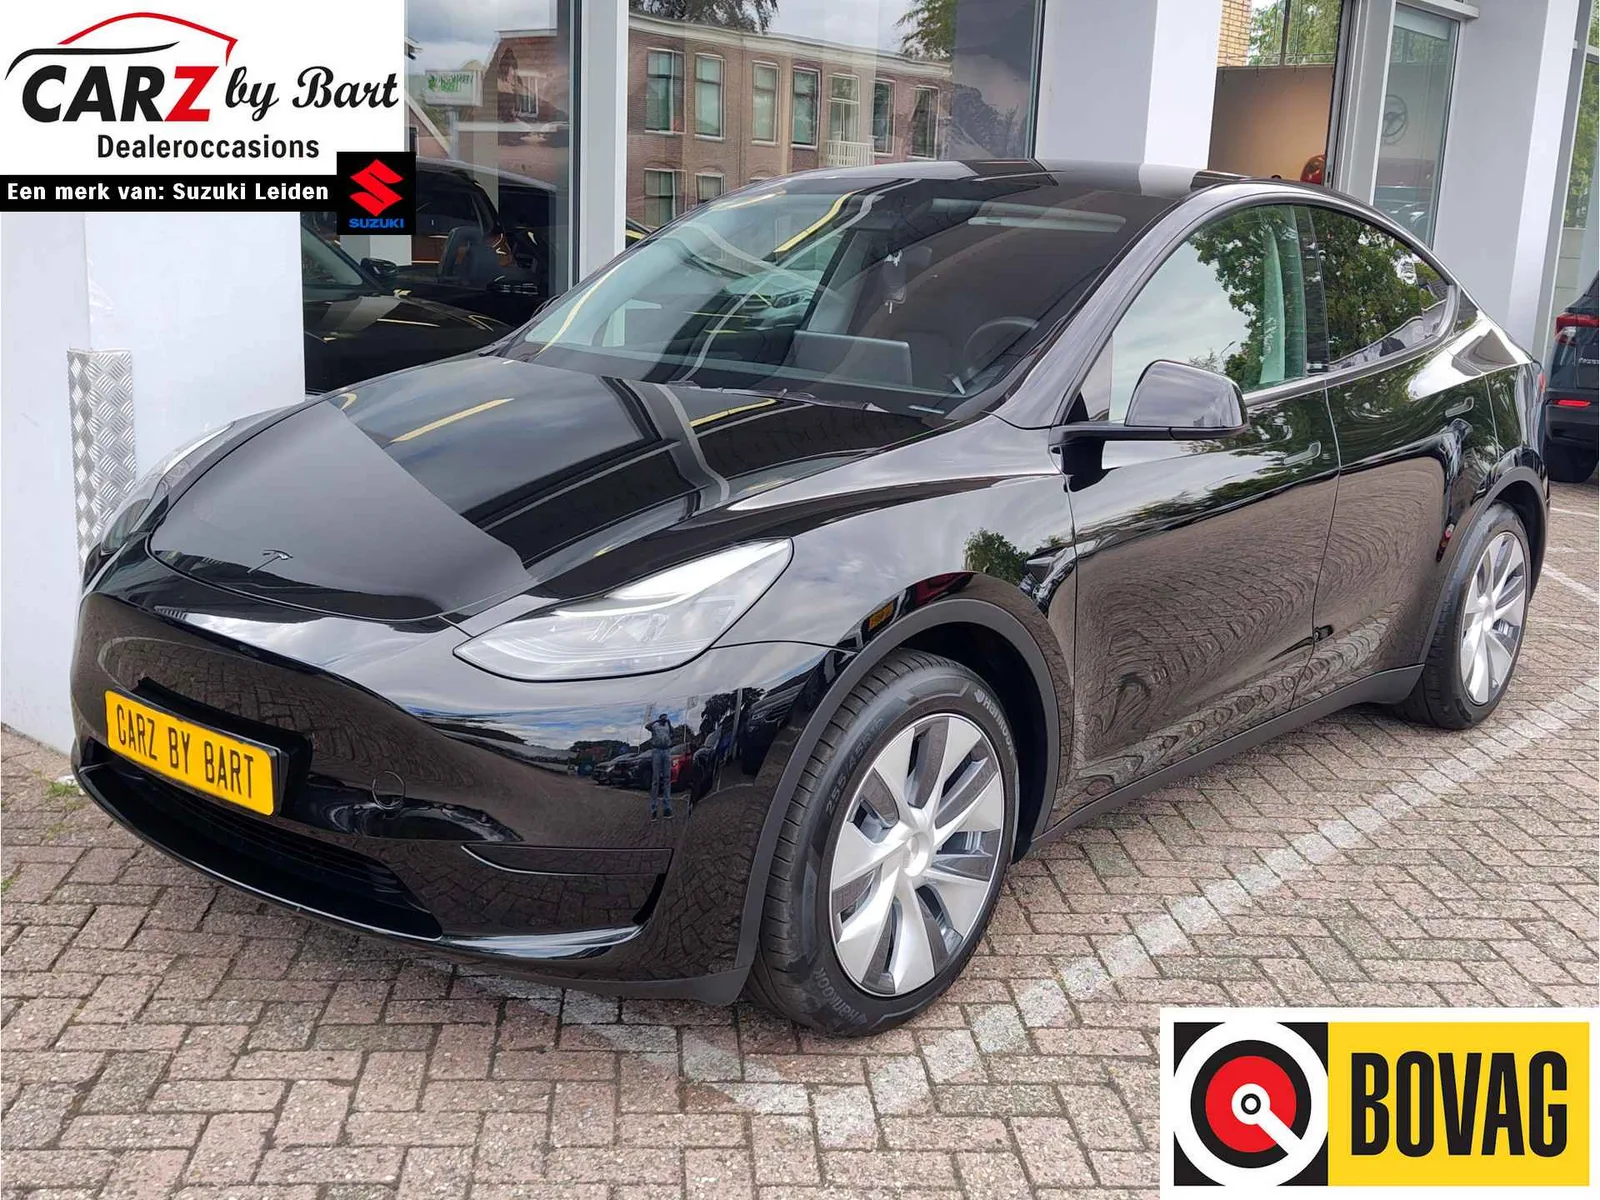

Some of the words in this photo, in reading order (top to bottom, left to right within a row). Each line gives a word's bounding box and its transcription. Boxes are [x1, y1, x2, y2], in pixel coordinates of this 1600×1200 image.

[116, 703, 158, 761] CARZ
[167, 727, 191, 775] BY
[203, 740, 254, 799] BART
